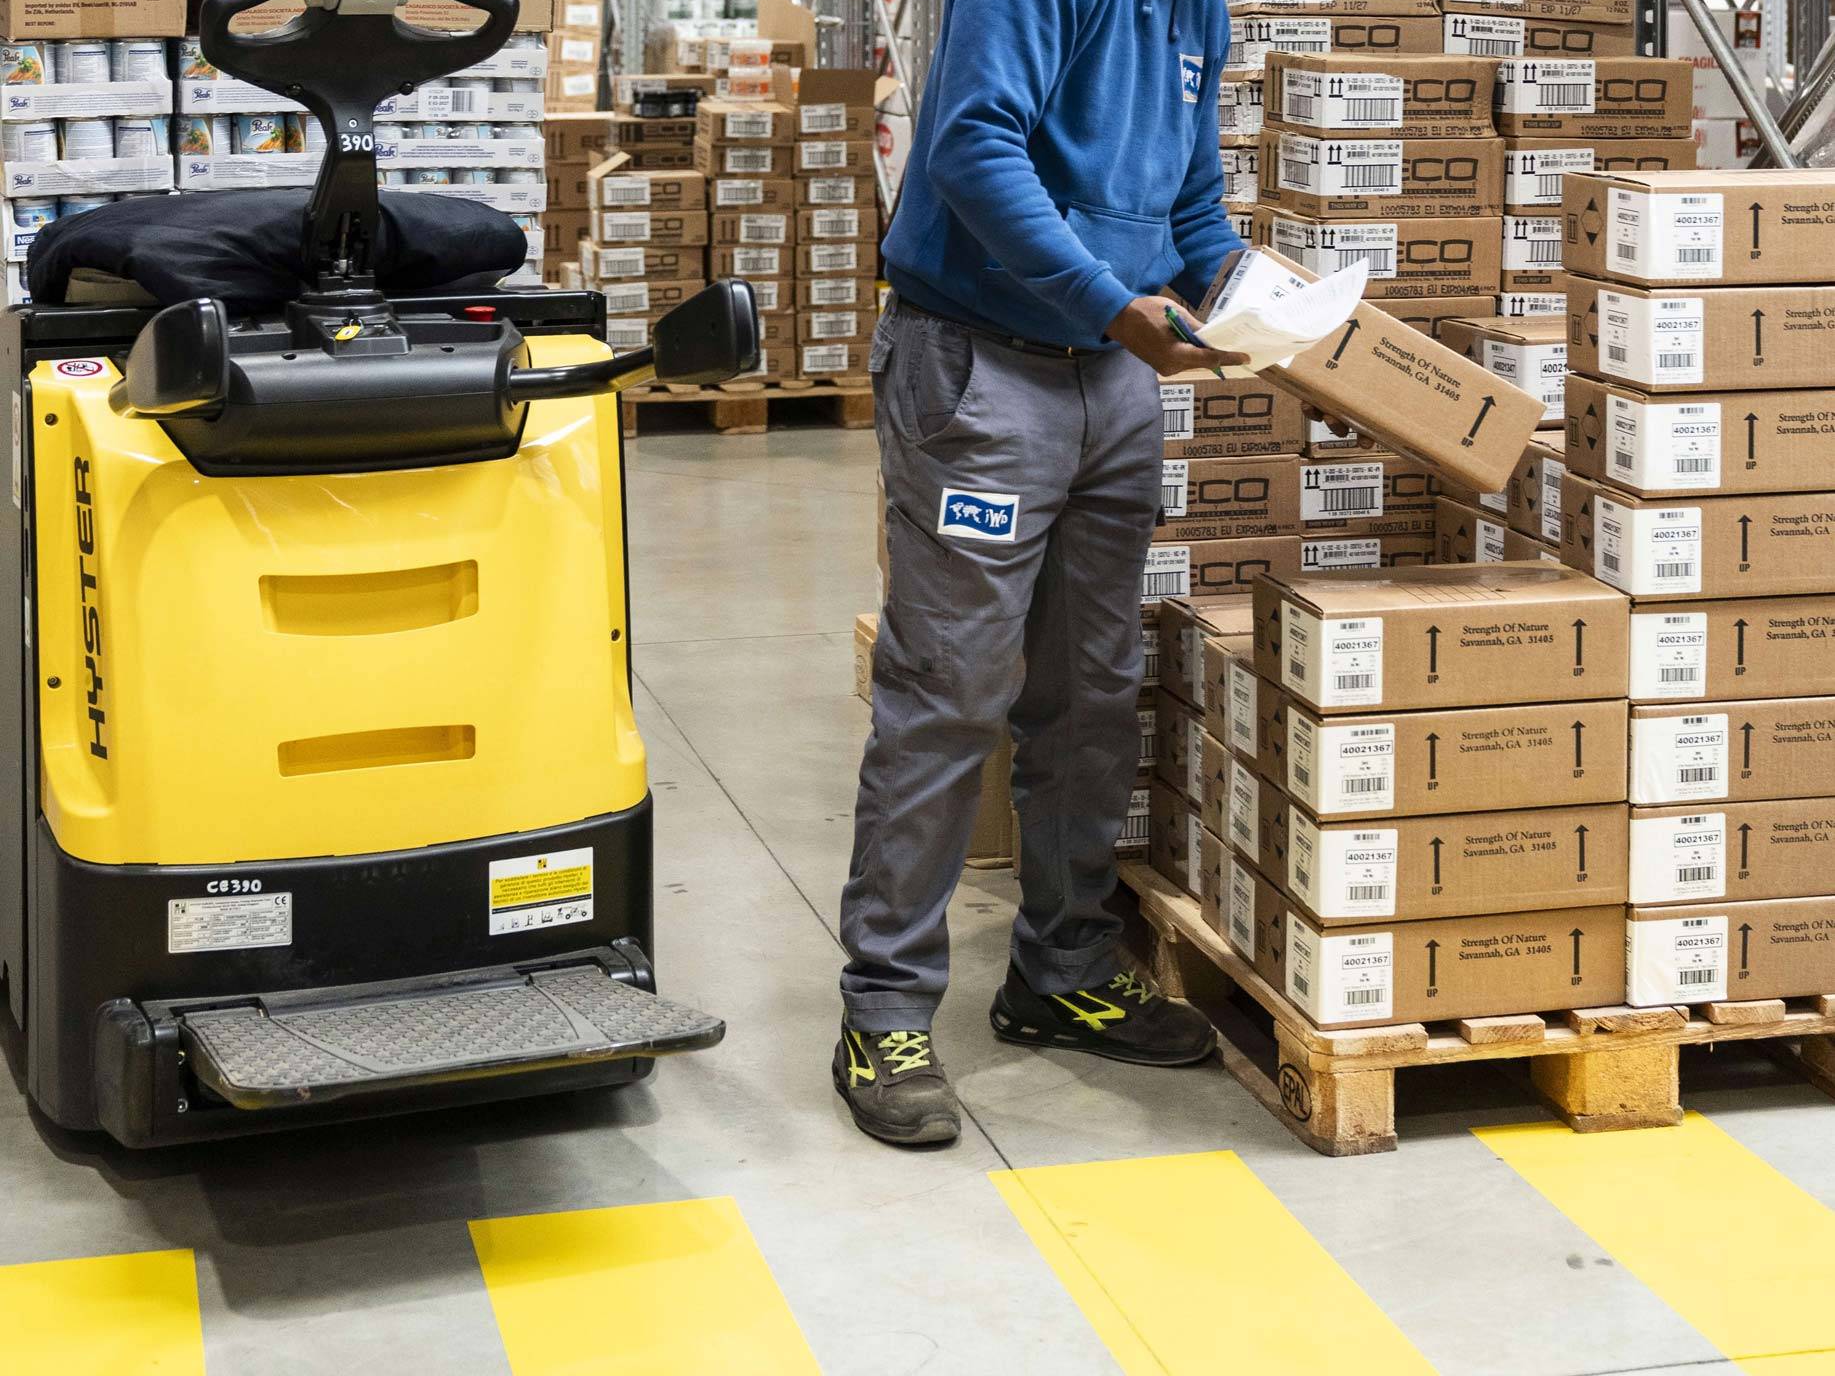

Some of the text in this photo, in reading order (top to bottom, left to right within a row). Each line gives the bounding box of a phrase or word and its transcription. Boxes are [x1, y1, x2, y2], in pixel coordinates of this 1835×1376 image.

[1541, 5, 1555, 14] EXP
[1560, 6, 1581, 15] 11/27
[192, 88, 212, 103] Peak
[10, 97, 30, 112] Peak
[251, 118, 275, 136] Peak
[340, 134, 373, 152] 390
[190, 163, 209, 178] Peak
[14, 175, 34, 189] Peak
[1676, 216, 1719, 224] 40021367
[1385, 286, 1424, 296] 10005783
[1427, 285, 1437, 294] EU
[1656, 321, 1698, 330] 40021367
[1325, 359, 1338, 371] UP
[1379, 336, 1462, 389] Strength Of Nature
[1371, 346, 1461, 402] Savannah, GA 31405
[1778, 412, 1829, 423] Strength Of
[1673, 425, 1716, 434] 40021367
[1776, 425, 1820, 435] Savannah,
[1460, 437, 1474, 449] UP
[1183, 445, 1223, 456] 10005783
[1226, 443, 1237, 453] EU
[1746, 461, 1757, 470] UP
[1772, 513, 1824, 525] Strength Of
[1175, 527, 1217, 538] 10005783
[1221, 525, 1232, 535] EU
[1654, 530, 1697, 539] 40021367
[1770, 526, 1830, 537] Savannah, GA
[1739, 563, 1750, 572] UP
[74, 455, 108, 760] HYSTER
[1768, 617, 1821, 629] Strength Of
[1462, 622, 1549, 636] Strength Of Nature
[1766, 629, 1826, 640] Savannah, GA
[1460, 634, 1554, 648] Savannah, GA 31405
[1659, 635, 1702, 644] 40021367
[1334, 640, 1379, 651] 40021367
[1573, 667, 1585, 677] UP
[1735, 666, 1746, 675] UP
[1427, 674, 1439, 684] UP
[1461, 726, 1548, 742] Strength Of Nature
[1677, 735, 1720, 744] 40021367
[1342, 743, 1392, 755] 40021367
[1459, 737, 1553, 754] Savannah, GA 31405
[1573, 769, 1585, 779] UP
[1427, 781, 1439, 791] UP
[1465, 830, 1552, 846] Strength Of Nature
[1675, 834, 1719, 844] 40021367
[1463, 841, 1557, 858] Savannah, GA 31405
[1347, 852, 1393, 862] 40021367
[1577, 873, 1588, 883] UP
[1431, 886, 1443, 896] UP
[274, 895, 287, 906] CE
[1461, 933, 1547, 949] Strength Of Nature
[1677, 938, 1720, 947] 40021367
[1458, 945, 1552, 961] Savannah, GA 31405
[1343, 955, 1389, 967] 40021367
[1571, 976, 1582, 986] UP
[1426, 989, 1438, 998] UP
[1284, 1070, 1308, 1117] EPAL
